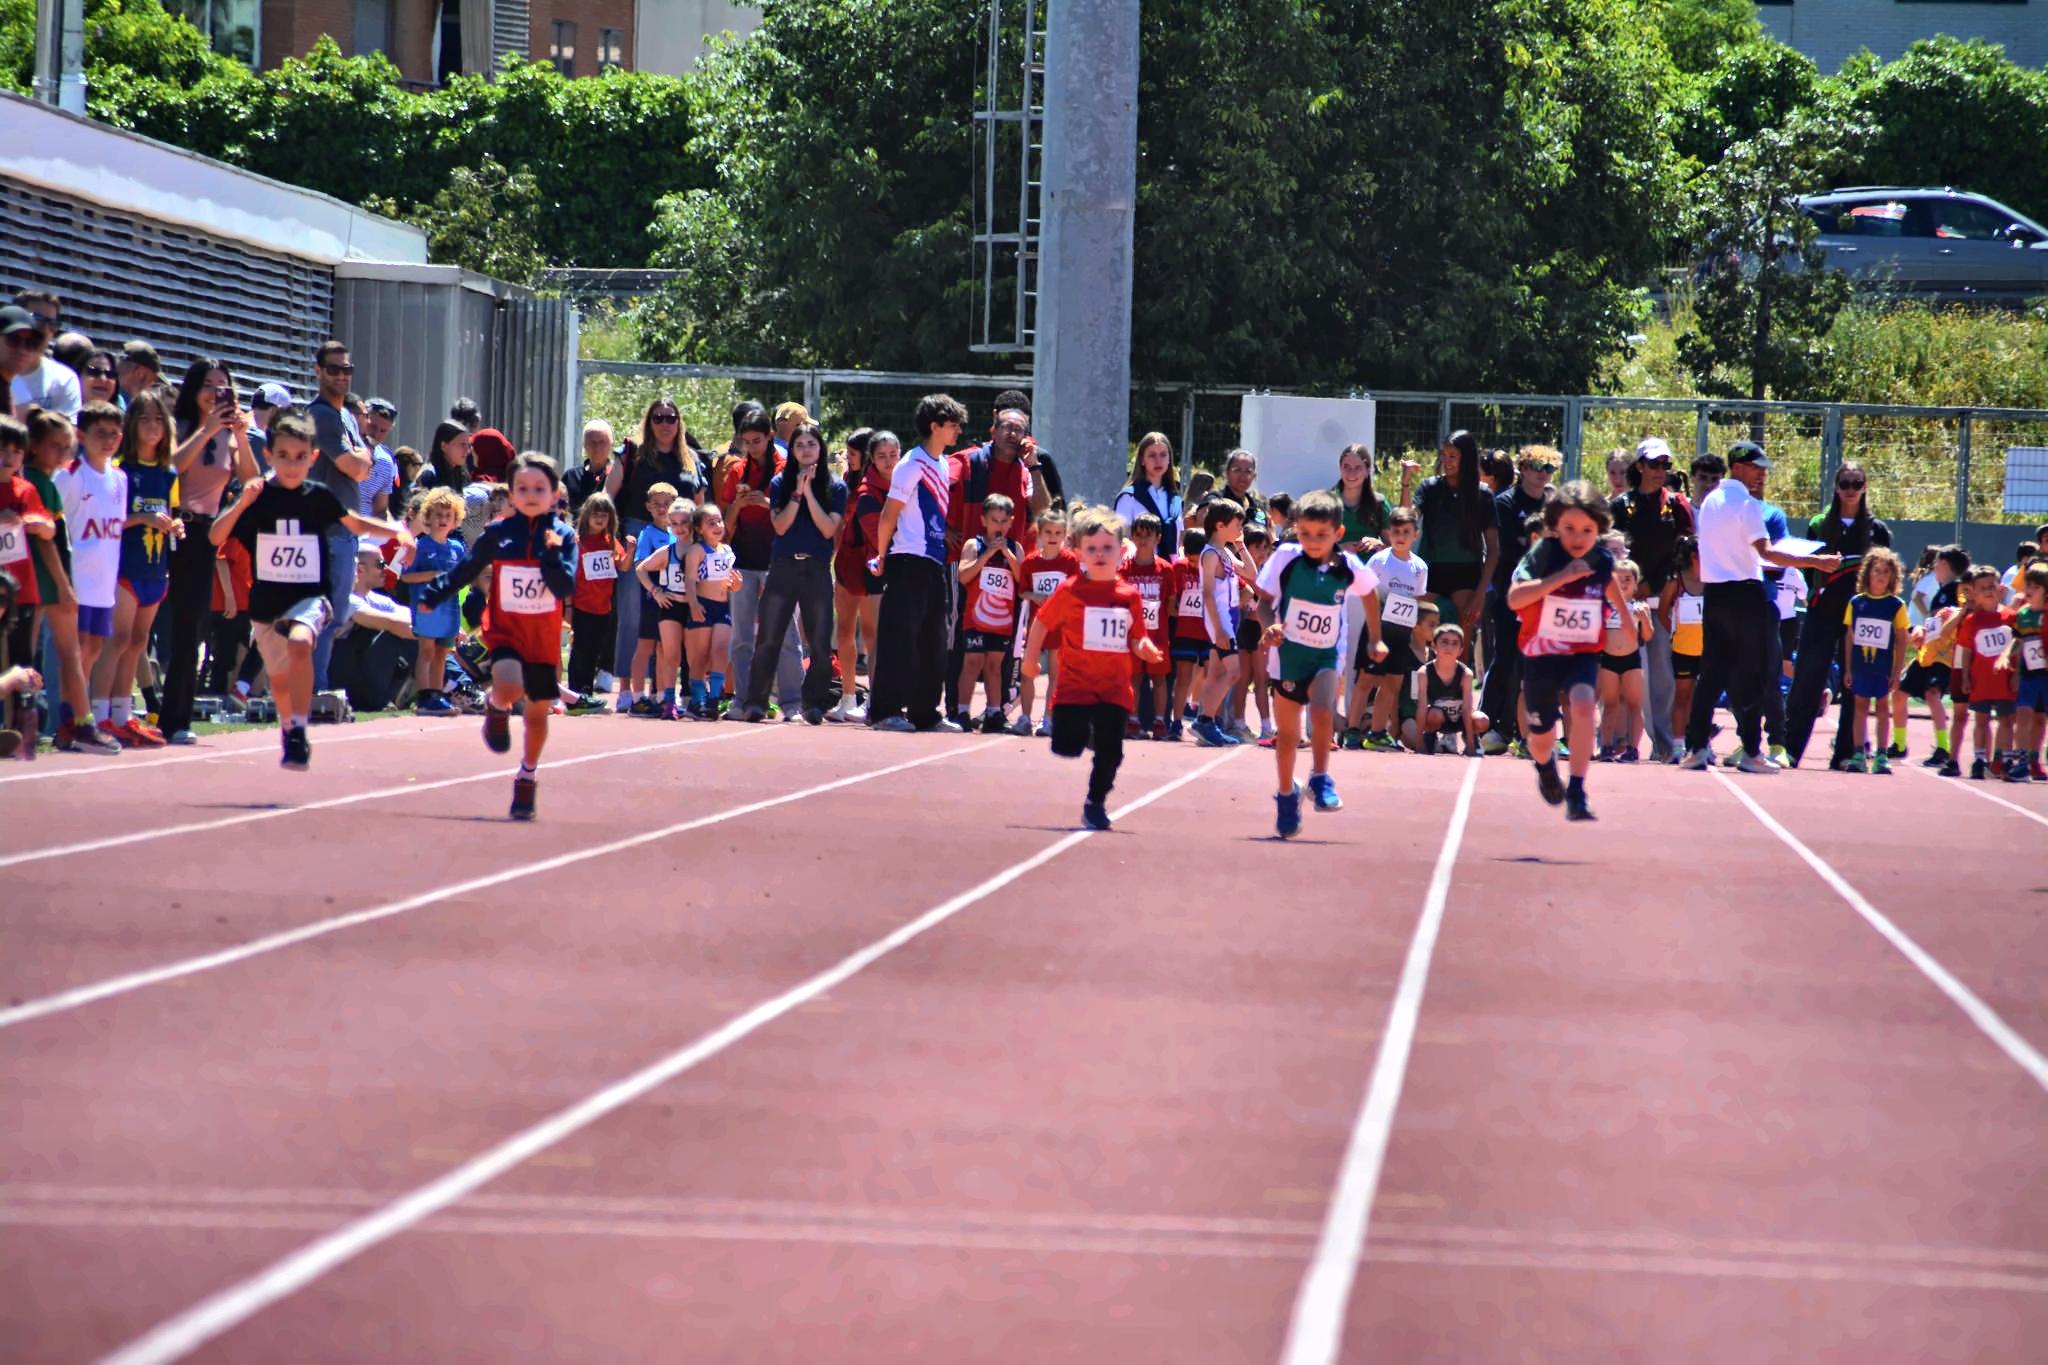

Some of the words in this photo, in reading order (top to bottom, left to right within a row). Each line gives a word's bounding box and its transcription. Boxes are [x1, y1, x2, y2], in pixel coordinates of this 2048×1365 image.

[271, 546, 307, 568] 676
[592, 557, 610, 572] 613
[512, 578, 546, 599] 567
[986, 573, 1009, 590] 582
[1037, 578, 1060, 593] 487
[1391, 601, 1414, 617] 277
[1296, 610, 1332, 635] 508
[1553, 608, 1591, 630] 565
[1101, 618, 1126, 638] 115
[1858, 624, 1883, 639] 390
[1984, 632, 2006, 648] 110
